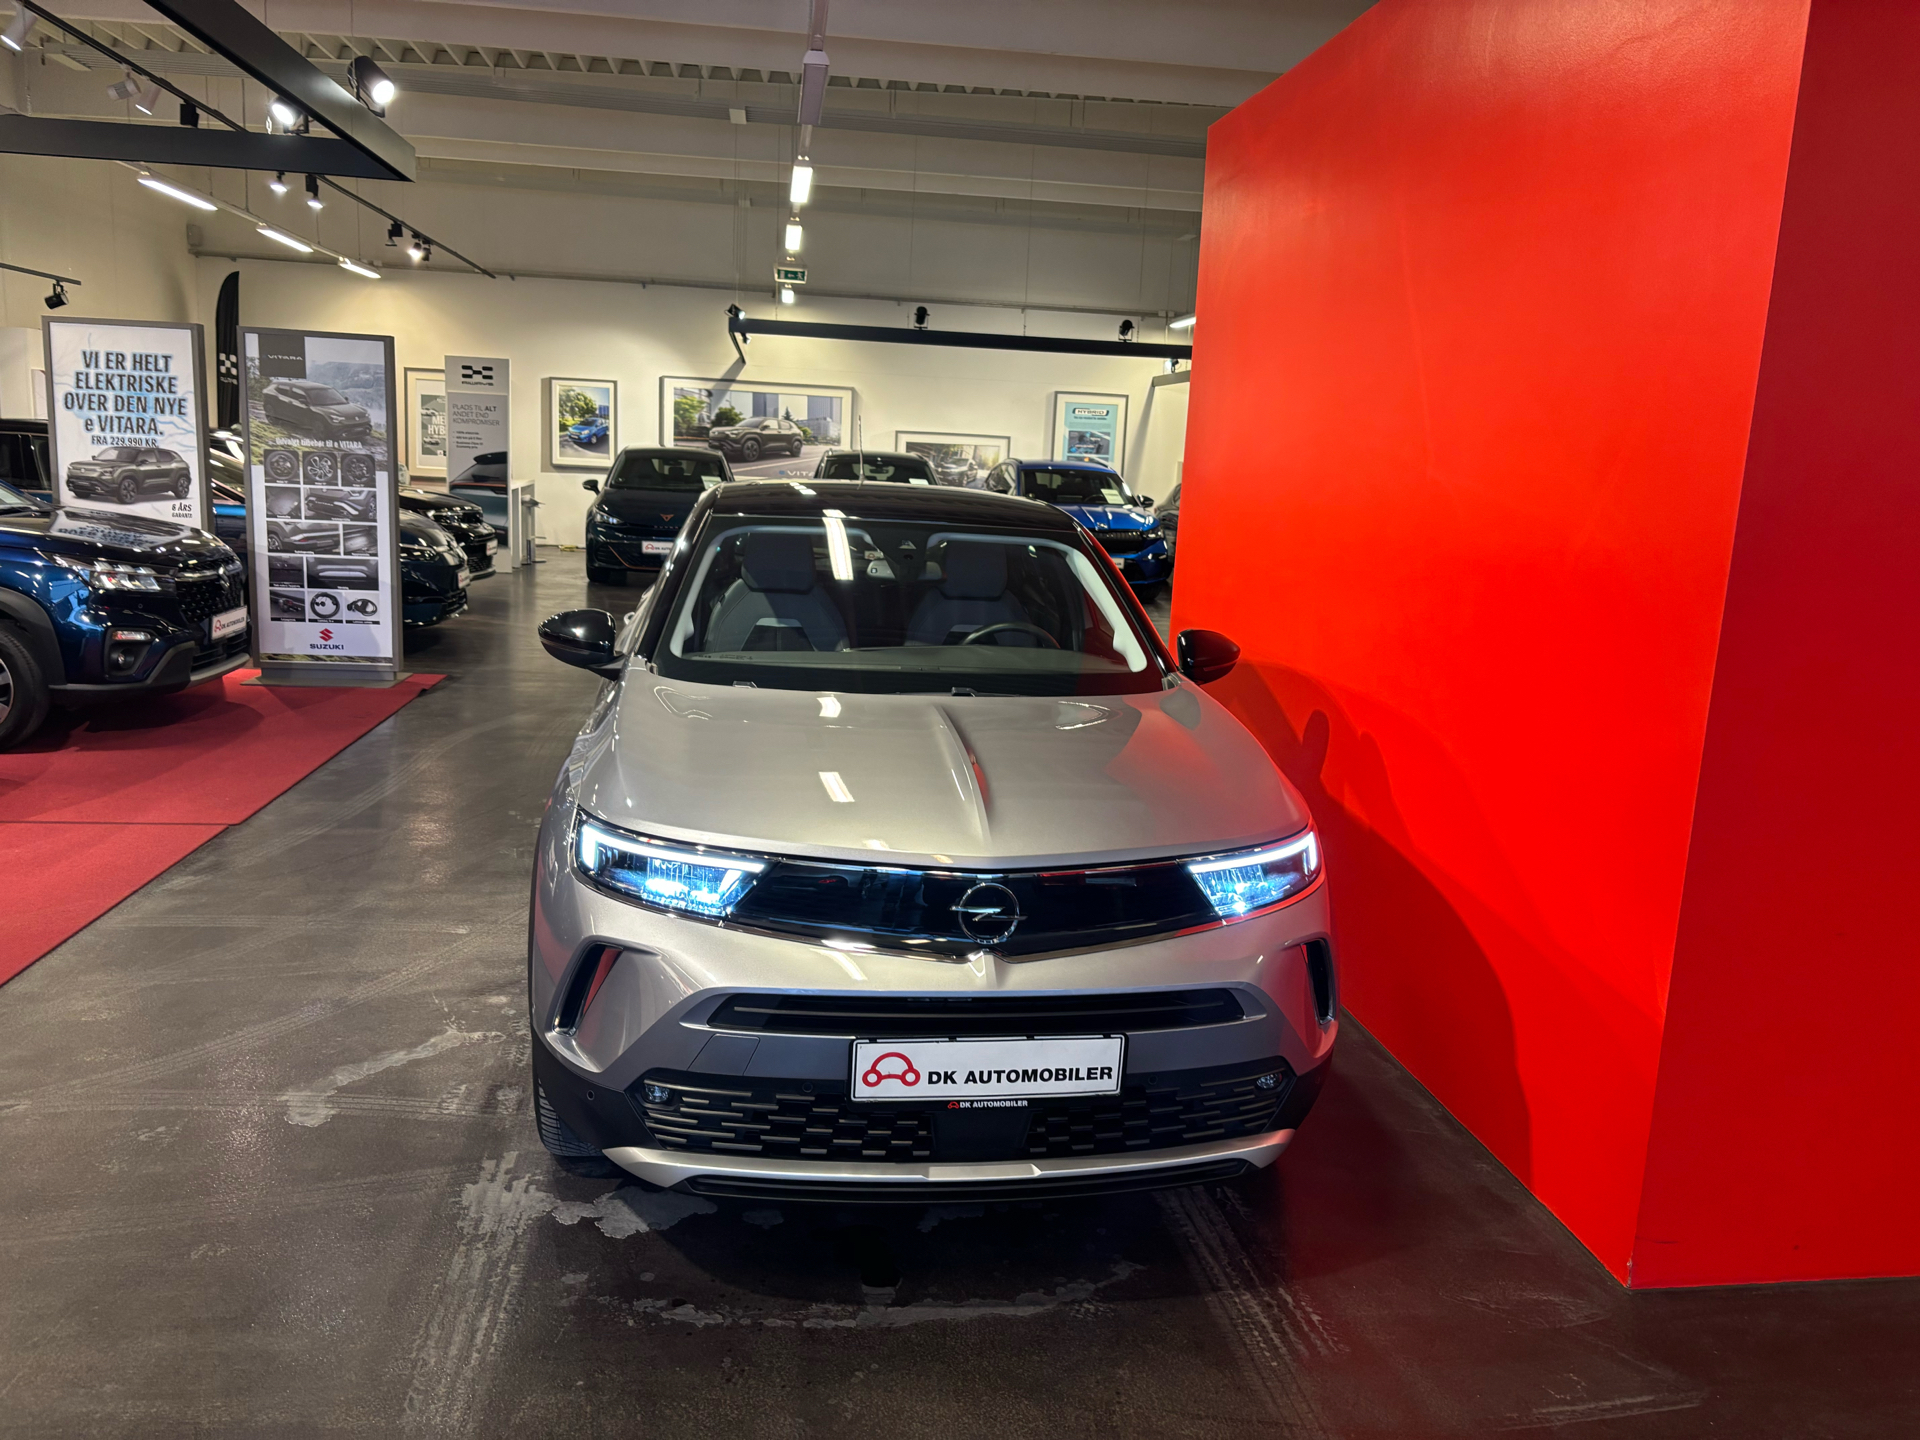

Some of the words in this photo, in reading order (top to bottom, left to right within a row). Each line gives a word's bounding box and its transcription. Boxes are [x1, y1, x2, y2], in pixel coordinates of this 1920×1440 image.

[82, 350, 99, 369] VI
[105, 352, 126, 371] ER
[132, 353, 172, 373] HELT
[75, 371, 177, 395] ELEKTRISKE
[64, 392, 108, 412] OVER
[114, 394, 147, 413] DEN
[154, 396, 187, 416] NYE
[452, 403, 473, 411] PLADS
[85, 417, 93, 432] e
[98, 415, 164, 436] VITARA.
[452, 418, 500, 426] KOMPROMISER
[91, 435, 107, 445] FRA
[109, 436, 142, 447] 229.990
[339, 440, 363, 449] VITARA
[178, 501, 192, 512] ÅRS
[927, 1070, 958, 1085] DK
[964, 1066, 1113, 1085] AUTOMOBILER
[972, 1100, 1028, 1108] AUTOMOBILER
